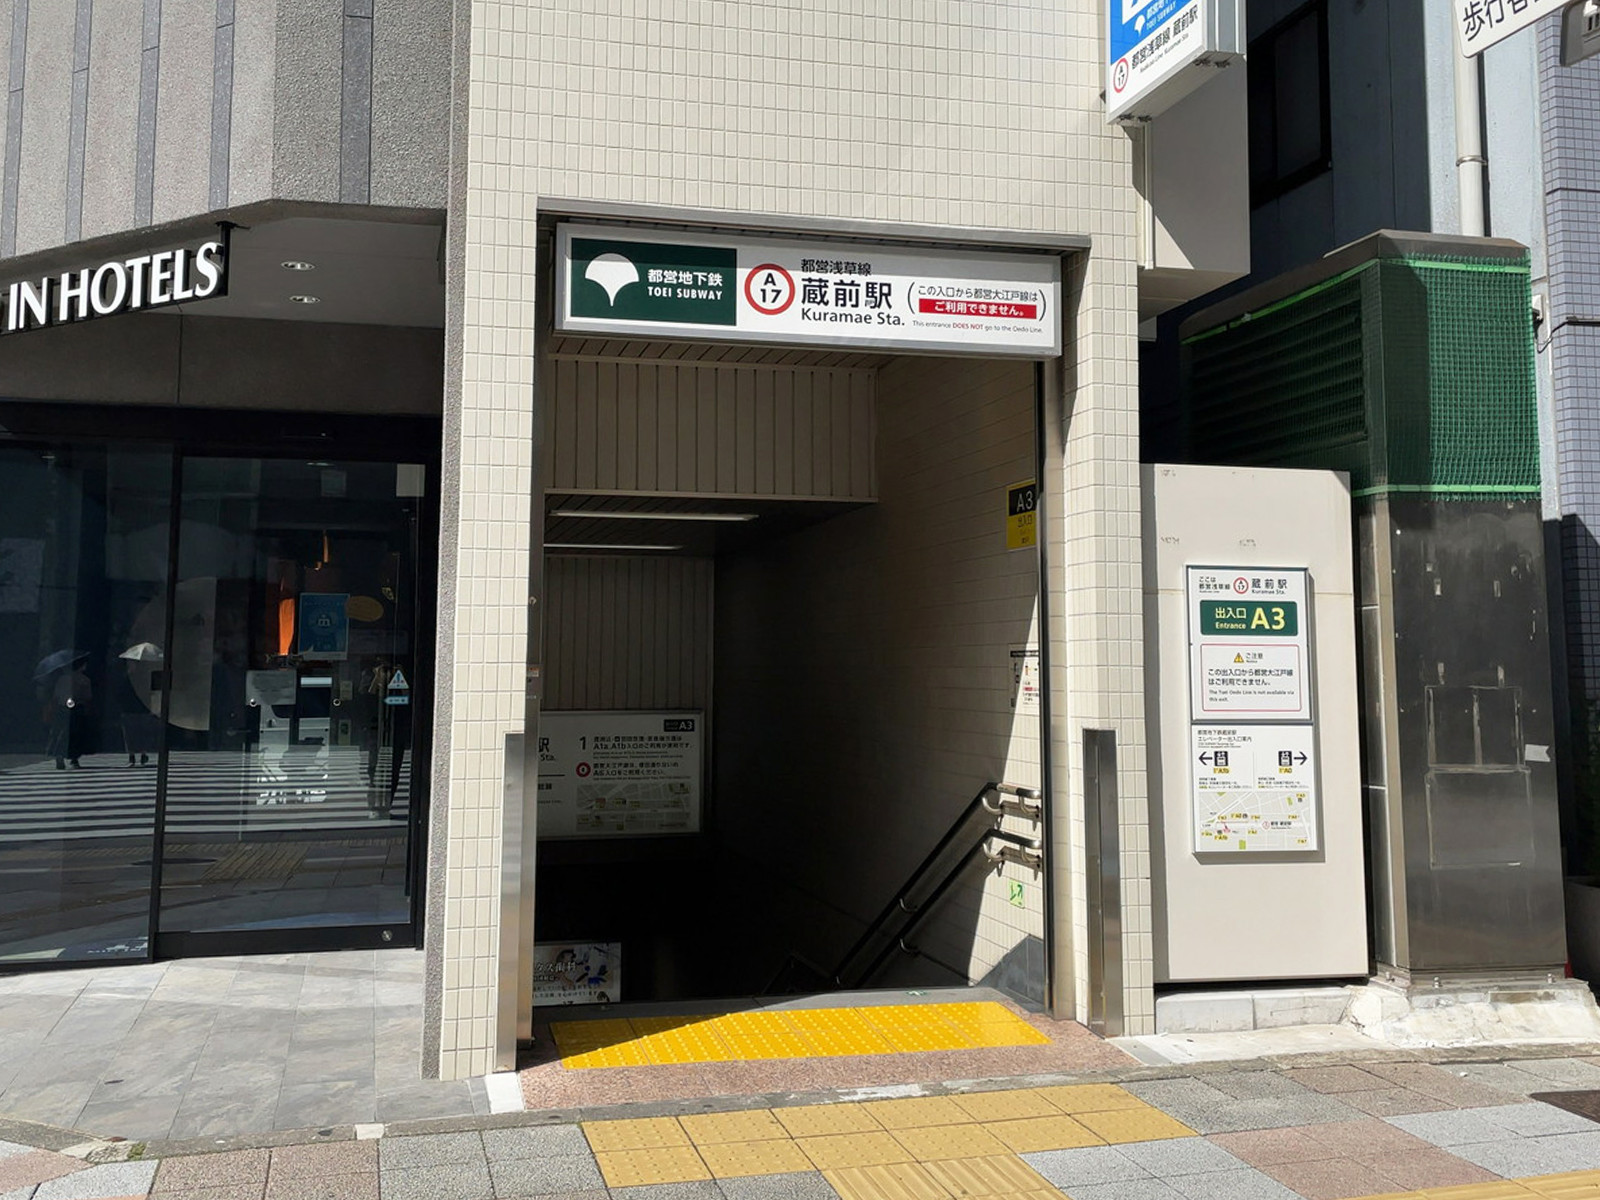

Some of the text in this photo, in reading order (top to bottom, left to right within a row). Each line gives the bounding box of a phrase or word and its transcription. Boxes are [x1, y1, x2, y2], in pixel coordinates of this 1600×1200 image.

[801, 258, 871, 277] 都営浅草線
[59, 242, 221, 321] HOTELS
[647, 268, 723, 287] 都営地下鉄
[764, 273, 777, 286] A
[647, 286, 723, 300] TOEI SUBWAY
[760, 288, 782, 304] 17
[801, 277, 893, 310] 蔵前駅
[801, 308, 905, 326] Kuramae Sta.
[1016, 490, 1034, 512] A3
[1251, 578, 1288, 589] 蔵前駅
[1215, 607, 1247, 619] 出入口
[1250, 607, 1286, 630] A3
[679, 721, 693, 731] A3
[579, 736, 586, 750] 1
